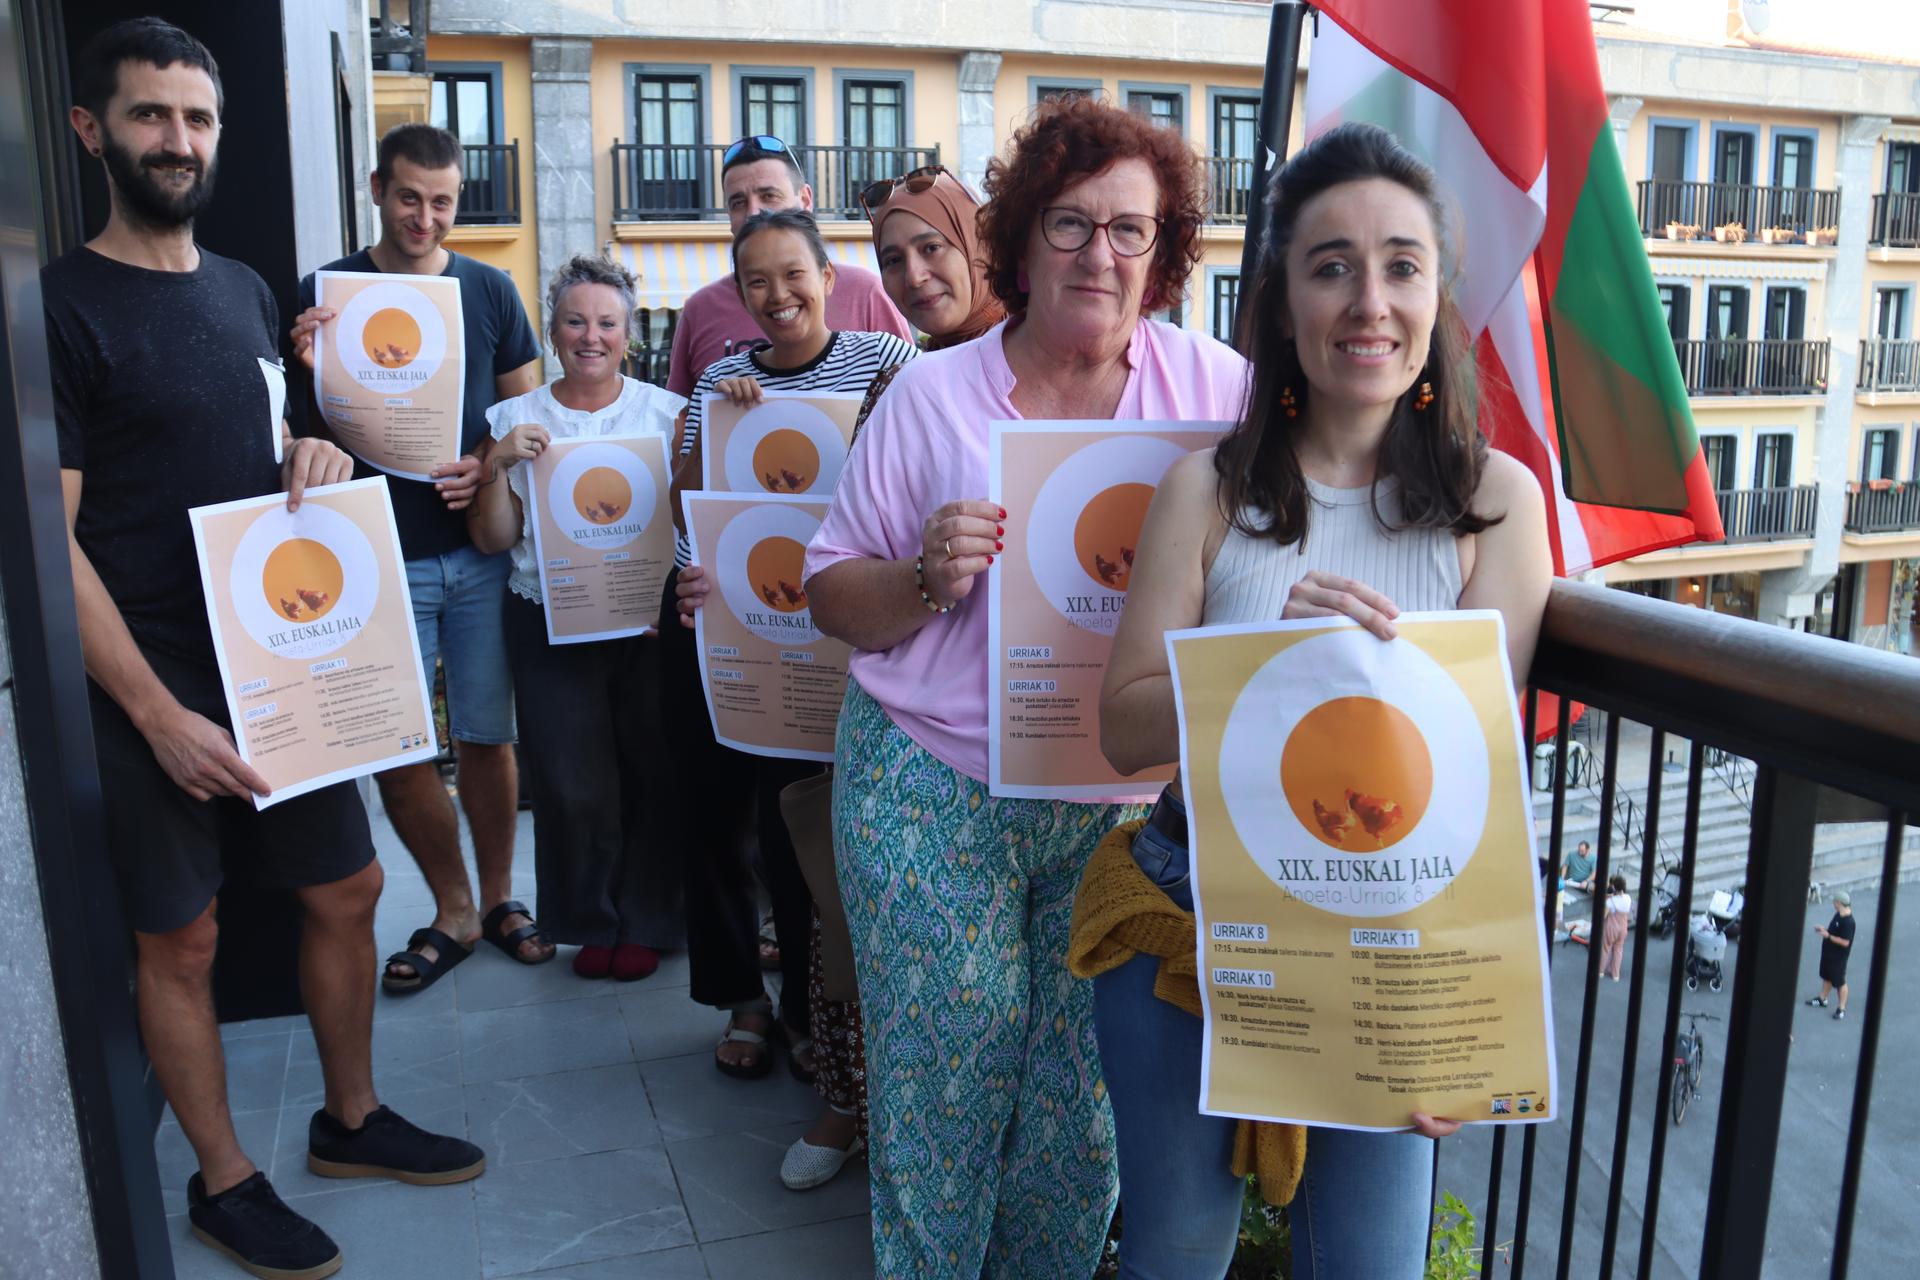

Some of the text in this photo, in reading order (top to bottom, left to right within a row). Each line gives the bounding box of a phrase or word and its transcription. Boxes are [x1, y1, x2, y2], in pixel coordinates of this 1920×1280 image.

[411, 371, 427, 381] JAIA
[592, 526, 624, 537] EUSKAL
[625, 524, 641, 535] JAIA
[1065, 597, 1096, 612] XIX.
[746, 613, 766, 624] XIX.
[769, 615, 807, 628] EUSKAL
[268, 617, 361, 648] XIX. EUSKAL JAIA
[1010, 648, 1049, 657] URRIAK 8
[1010, 682, 1054, 691] URRIAK 10
[1278, 856, 1455, 885] XIX. EUSKAL JAIA
[1415, 885, 1424, 903] 8
[1214, 925, 1264, 939] URRIAK 8
[1354, 931, 1414, 945] URRIAK 11
[1214, 944, 1232, 952] 17:15.
[1352, 951, 1370, 959] 10:00.
[1214, 971, 1271, 985] URRIAK 10
[1352, 977, 1372, 985] 11:30.
[1352, 1002, 1372, 1010] 12:00.
